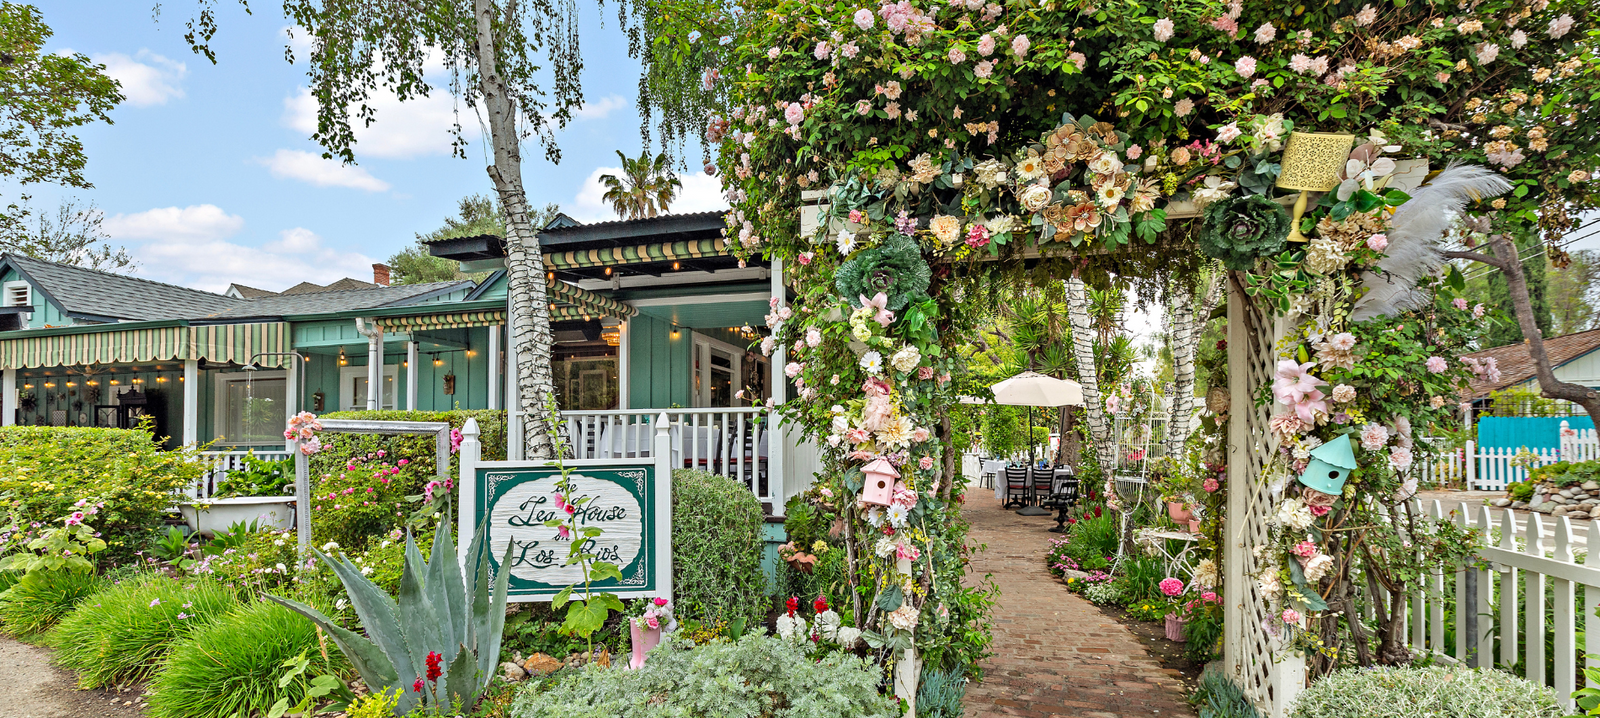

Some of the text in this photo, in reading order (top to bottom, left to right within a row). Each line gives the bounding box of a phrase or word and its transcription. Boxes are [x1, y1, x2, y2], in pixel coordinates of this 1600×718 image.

[508, 494, 627, 526] Tea House
[512, 537, 623, 568] Los Rios
